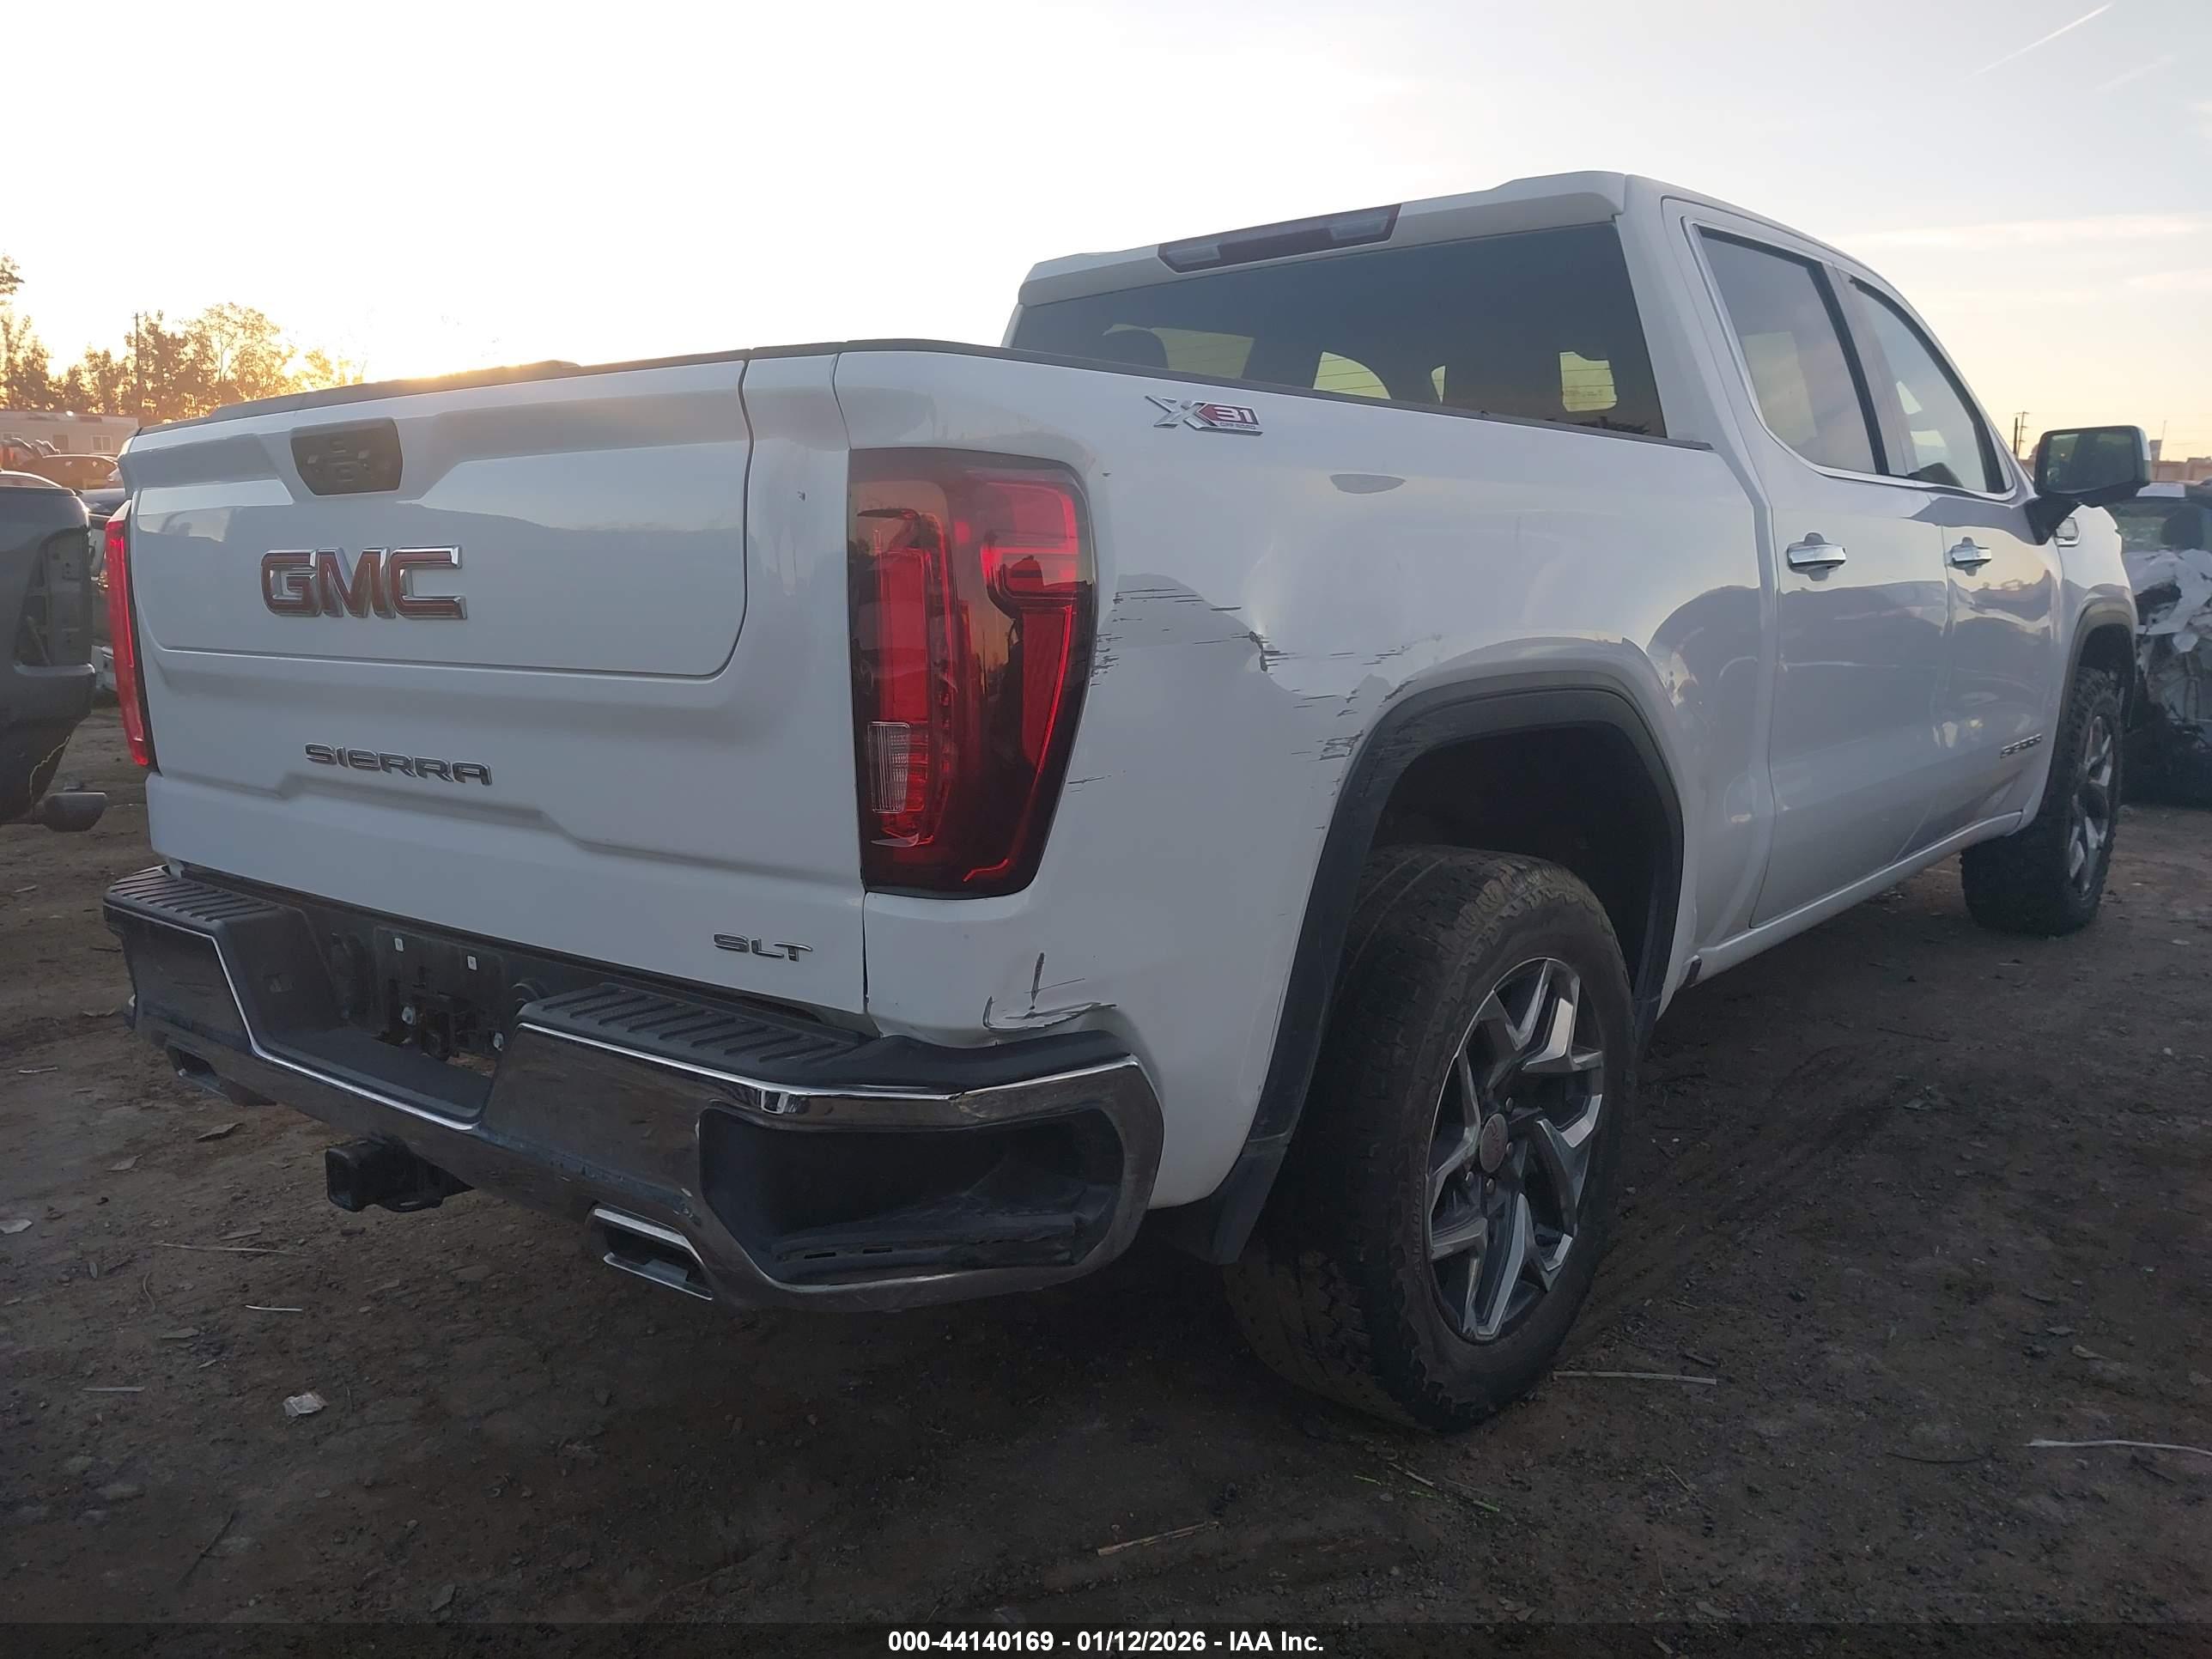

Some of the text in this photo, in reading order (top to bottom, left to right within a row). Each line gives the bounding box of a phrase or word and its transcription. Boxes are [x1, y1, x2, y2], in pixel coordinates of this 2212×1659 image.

[1145, 395, 1262, 436] X31
[261, 545, 468, 620] GMC
[305, 742, 493, 786] SIERRA
[714, 933, 814, 962] SLT
